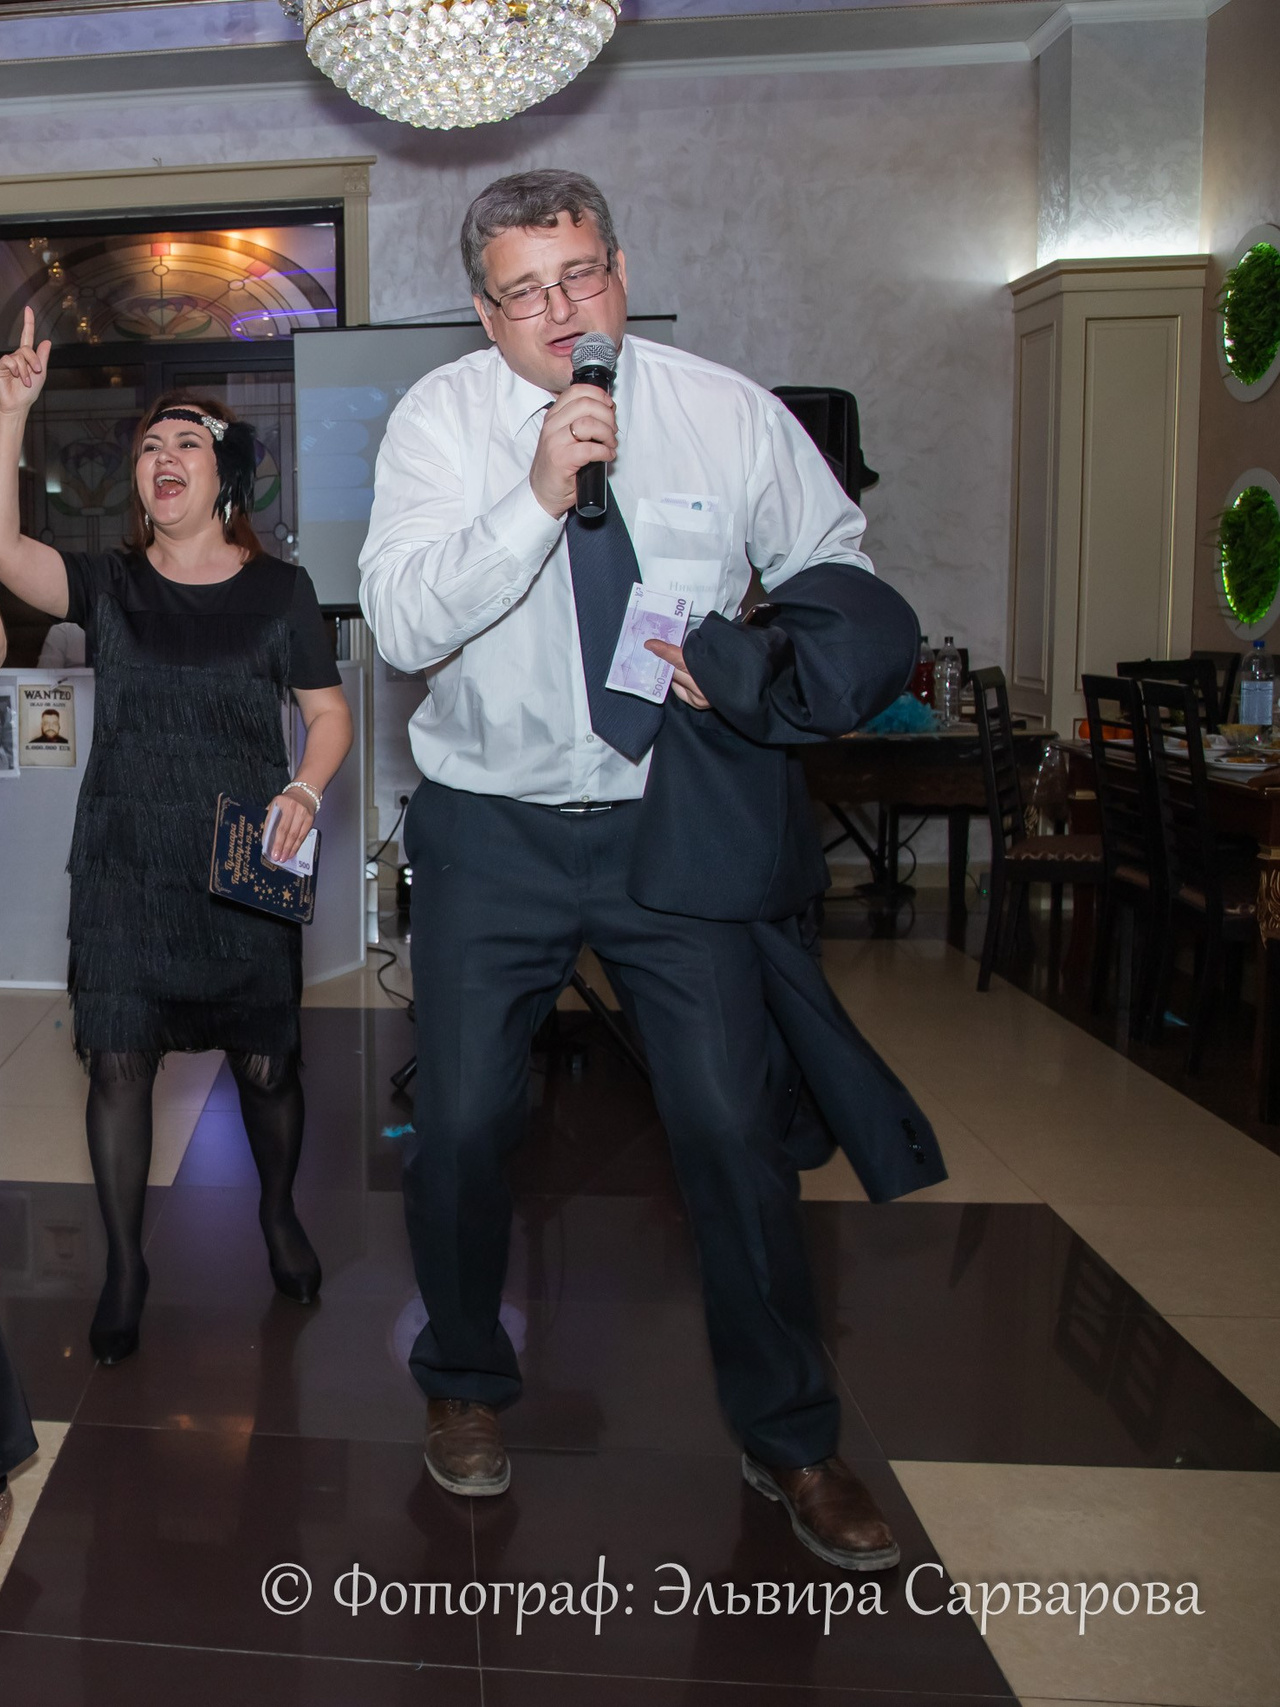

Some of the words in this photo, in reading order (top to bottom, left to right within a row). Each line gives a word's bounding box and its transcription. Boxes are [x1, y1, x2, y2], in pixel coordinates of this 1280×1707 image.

[674, 598, 687, 617] 500
[652, 677, 666, 697] 500
[24, 689, 71, 701] WANTED
[298, 860, 311, 870] 500
